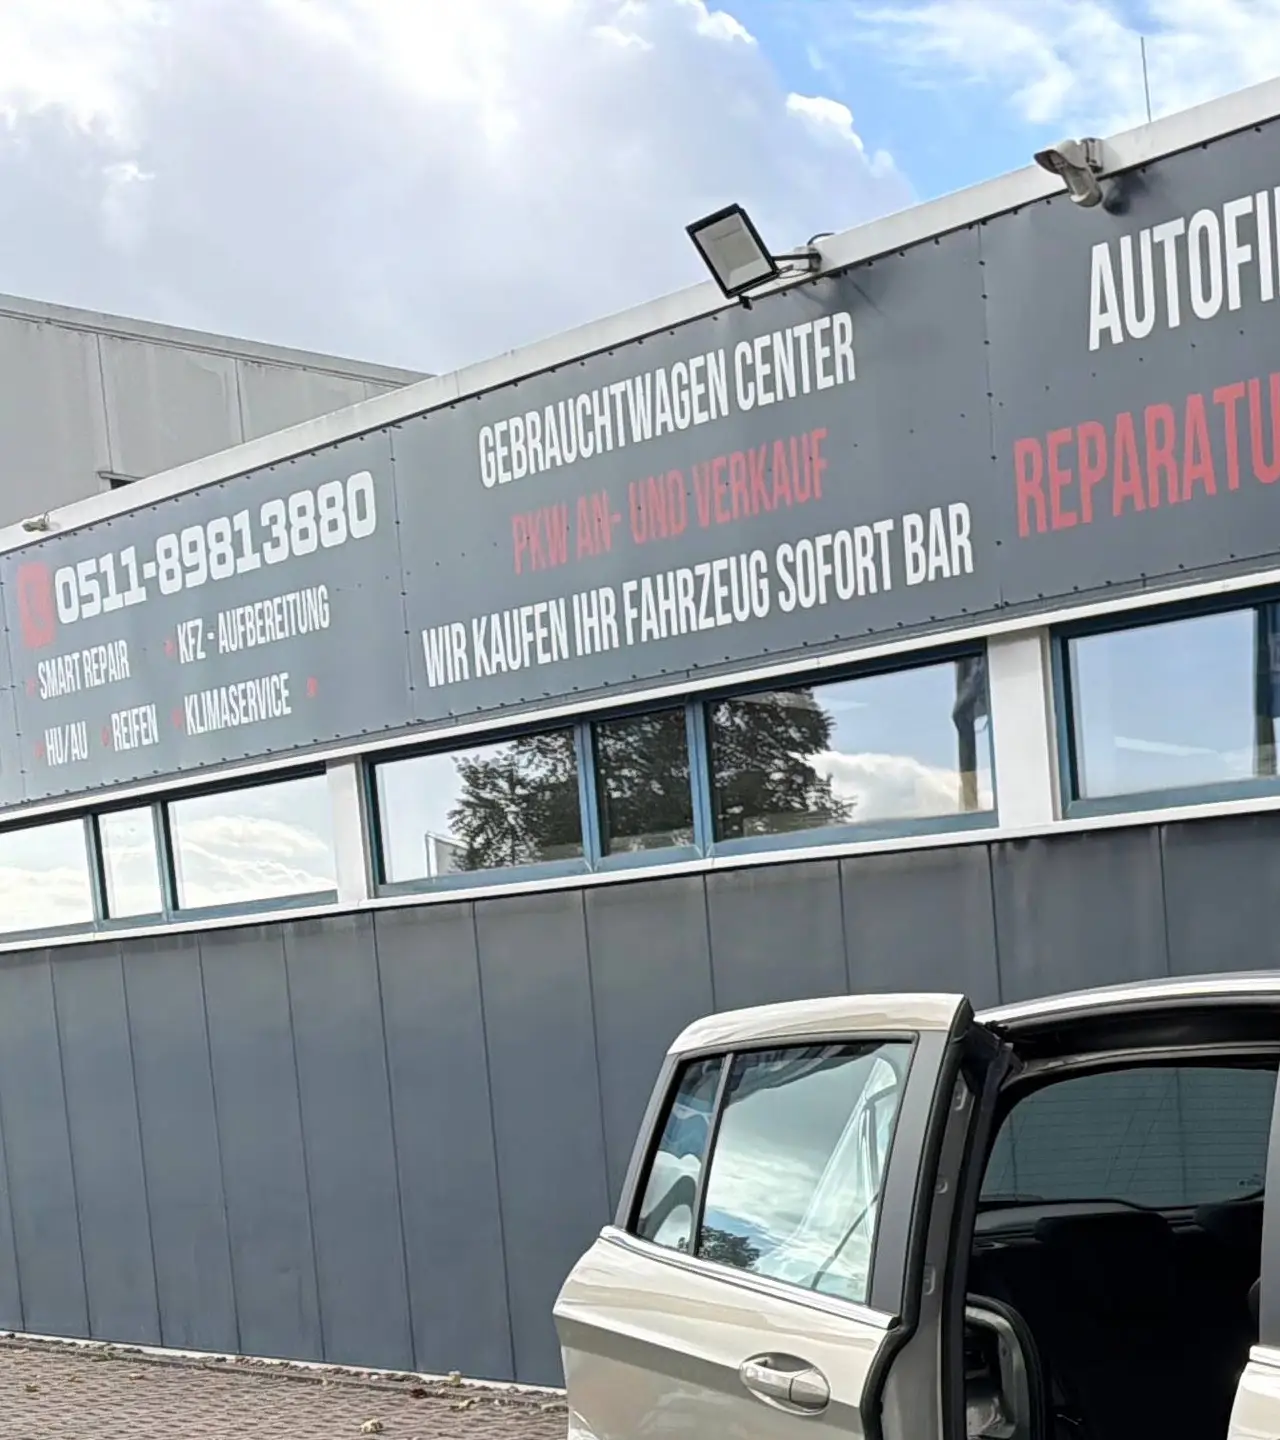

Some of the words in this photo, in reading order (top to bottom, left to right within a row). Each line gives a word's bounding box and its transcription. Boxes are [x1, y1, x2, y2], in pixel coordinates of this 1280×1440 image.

[478, 348, 729, 489] GEBRAUCHTWAGEN
[734, 311, 855, 408] CENTER
[54, 471, 377, 624] 0511-89813880
[511, 504, 569, 575] PKW
[576, 490, 621, 560] AN-
[628, 467, 688, 546] UND
[692, 428, 829, 530] VERKAUF
[37, 649, 83, 700] SMART
[84, 640, 131, 687] REPAIR
[177, 618, 207, 664] KFZ
[217, 585, 330, 654] AUFBEREITUNG
[422, 618, 469, 688] WIR
[472, 598, 569, 680] KAUFEN
[573, 586, 620, 657] IHR
[622, 548, 769, 647] FAHRZEUG
[776, 518, 894, 613] SOFORT
[903, 502, 974, 586] BAR
[44, 721, 88, 766] HU/AU
[111, 704, 159, 752] REIFEN
[183, 672, 292, 736] KLIMASERVICE
